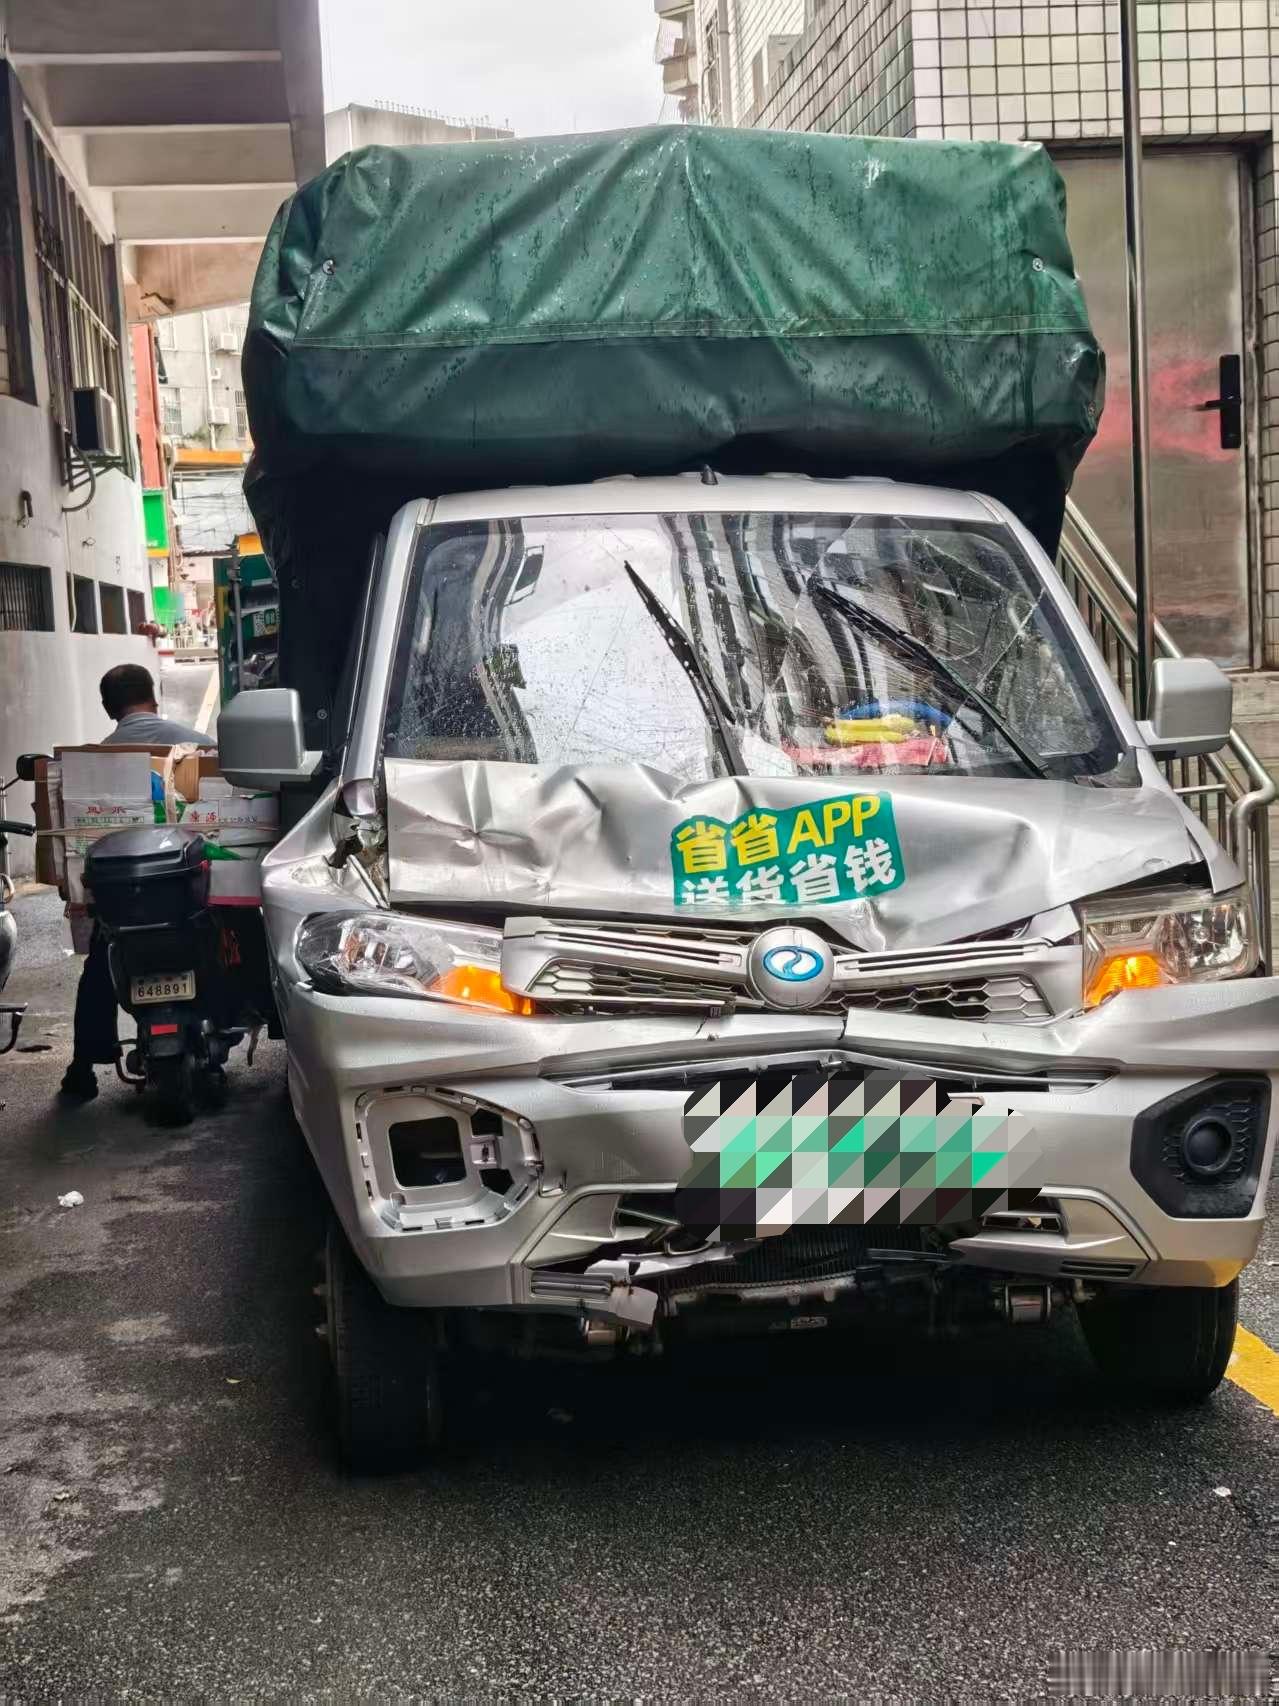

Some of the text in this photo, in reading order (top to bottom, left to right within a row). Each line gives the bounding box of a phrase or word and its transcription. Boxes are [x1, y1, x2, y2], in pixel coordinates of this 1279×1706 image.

[676, 795, 880, 873] 省省APP
[681, 838, 896, 905] 送货省钱
